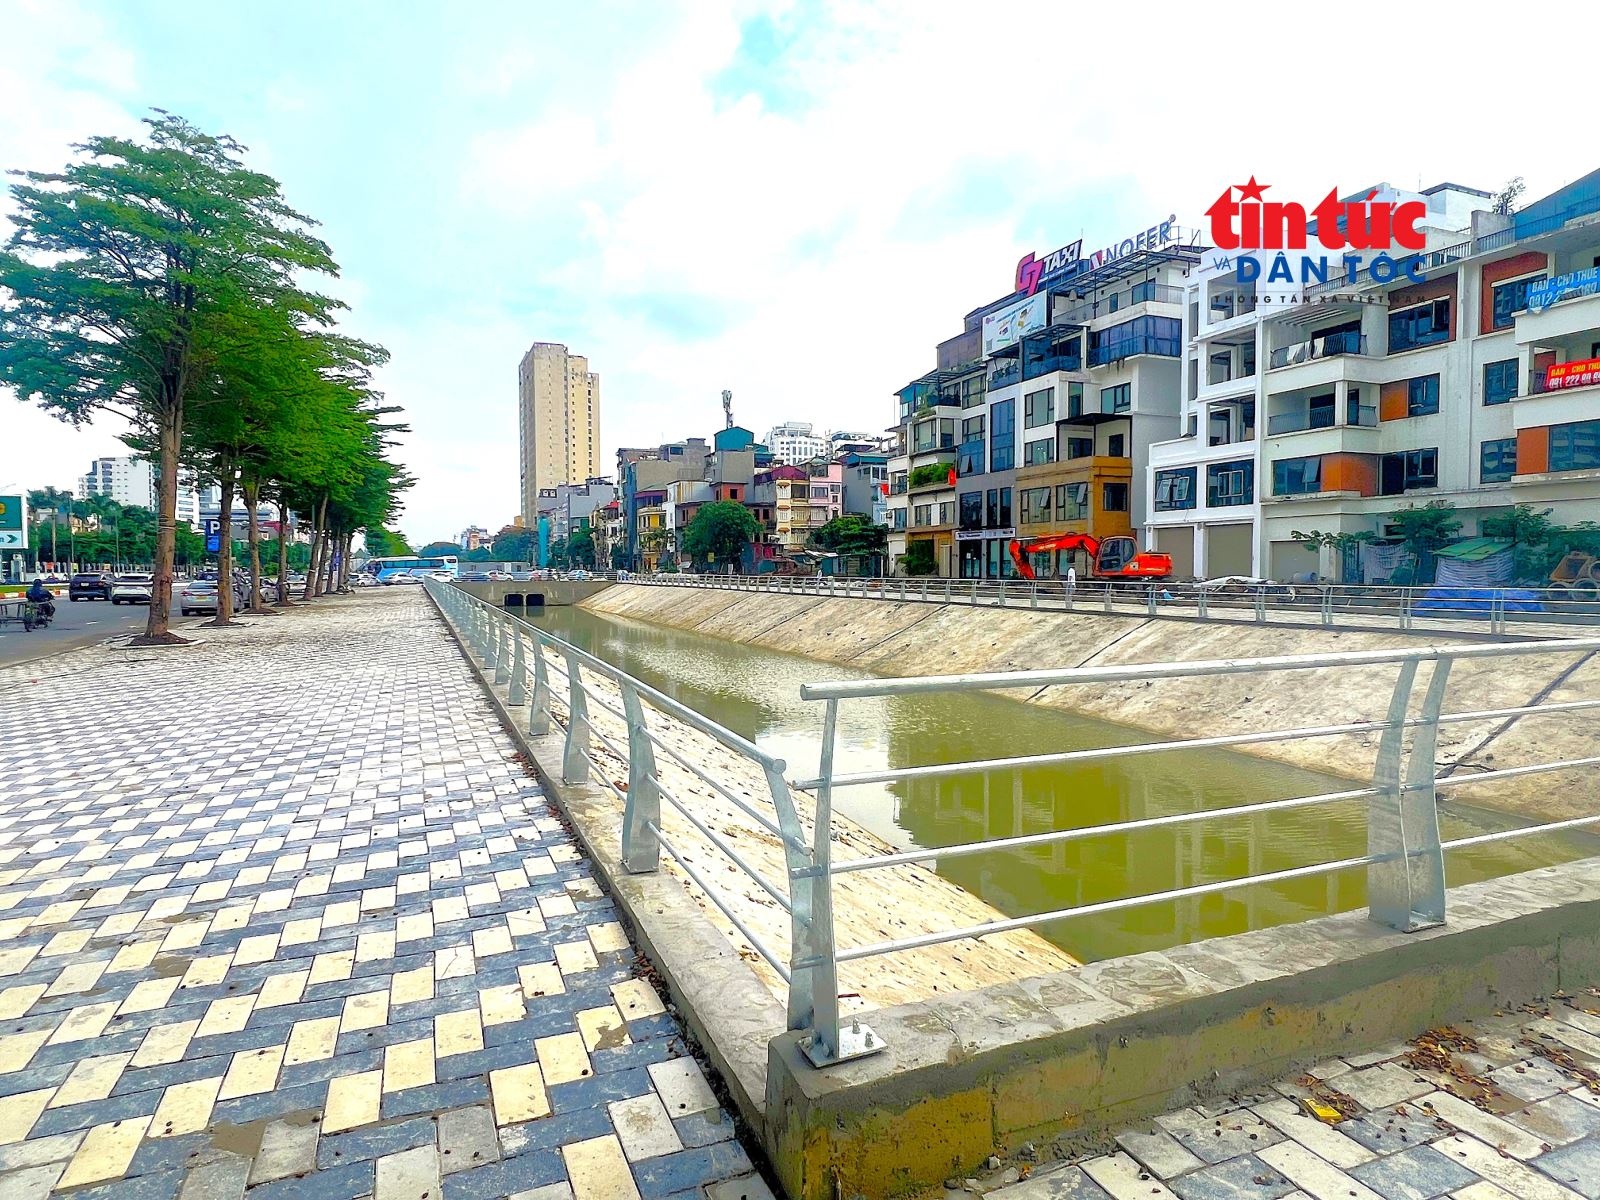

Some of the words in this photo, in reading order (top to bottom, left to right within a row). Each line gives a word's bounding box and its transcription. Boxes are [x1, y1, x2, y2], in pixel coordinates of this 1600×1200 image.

[1043, 241, 1080, 274] TAXI
[1565, 374, 1580, 387] 222
[210, 521, 220, 534] P
